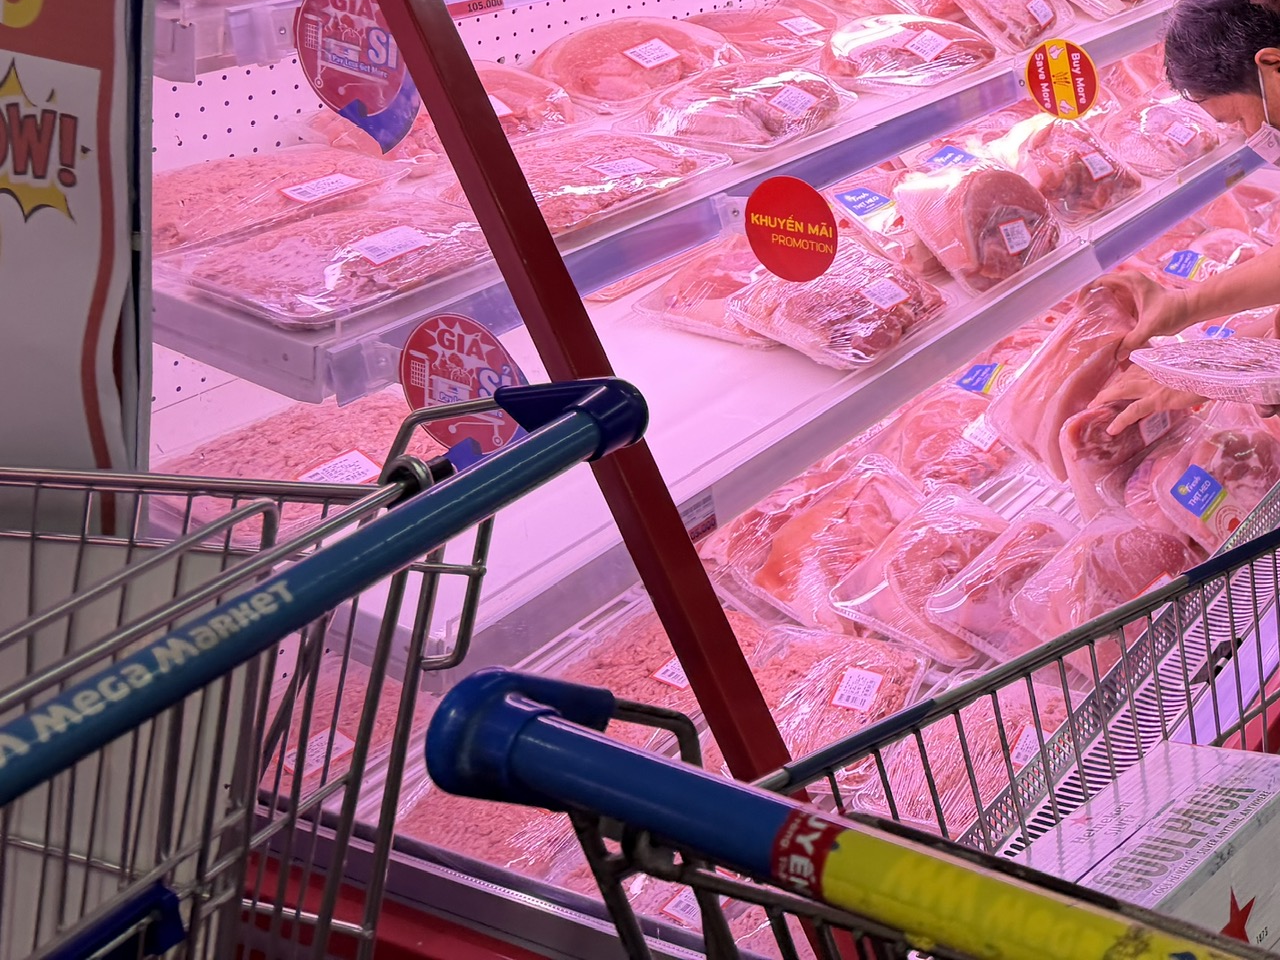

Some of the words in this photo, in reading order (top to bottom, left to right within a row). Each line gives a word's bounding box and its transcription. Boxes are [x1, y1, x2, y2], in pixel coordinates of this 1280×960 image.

[1071, 52, 1081, 74] Buy
[1034, 53, 1046, 80] Save
[1040, 83, 1052, 109] More
[1075, 77, 1087, 104] More
[750, 213, 804, 233] KHUYẾN
[807, 222, 833, 238] MÃI
[771, 233, 834, 254] PROMOTION
[30, 662, 153, 742] Mega
[150, 580, 295, 674] Market
